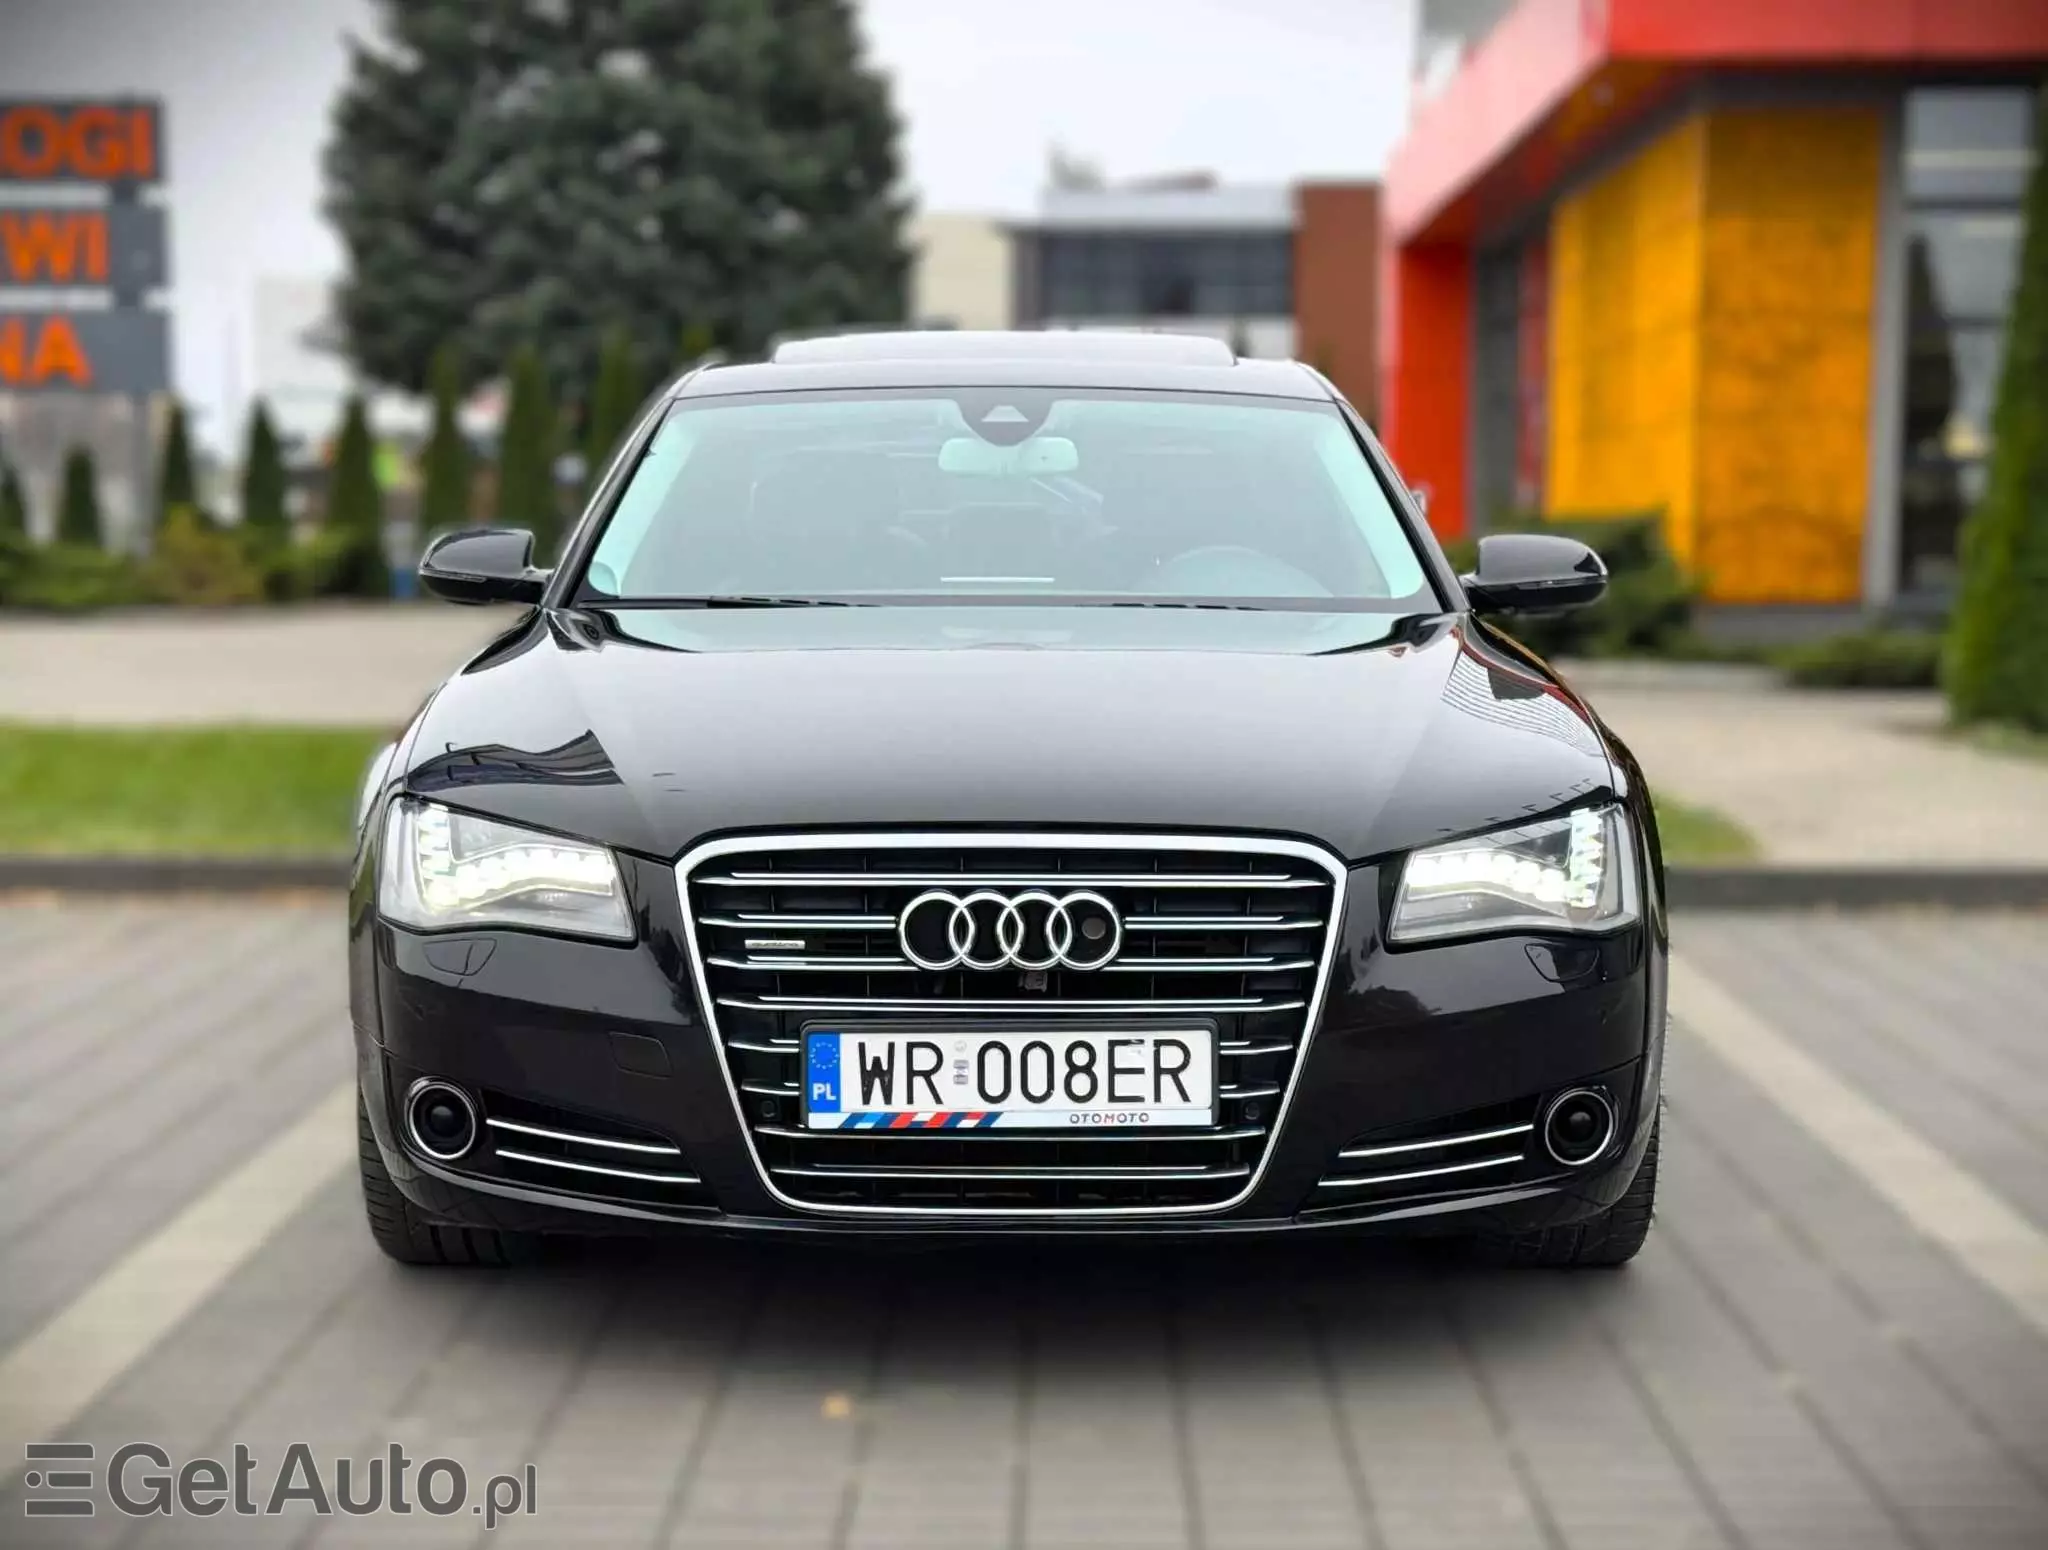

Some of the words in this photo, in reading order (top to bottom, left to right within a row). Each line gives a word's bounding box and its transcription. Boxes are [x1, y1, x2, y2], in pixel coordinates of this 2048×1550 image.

[858, 1041, 944, 1106] WR
[977, 1039, 1191, 1104] 008ER
[812, 1082, 837, 1101] PL
[1069, 1112, 1150, 1124] OTOMOTO
